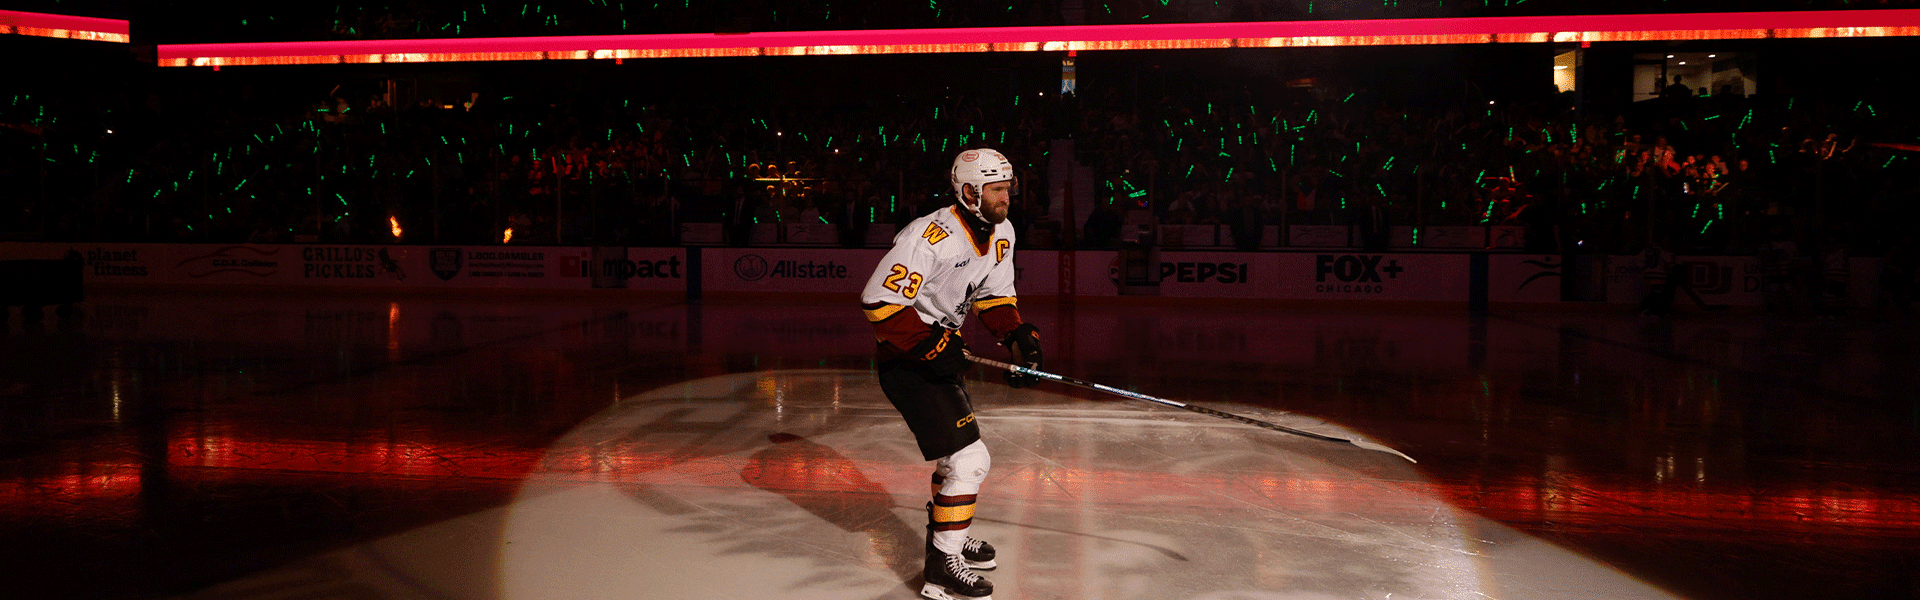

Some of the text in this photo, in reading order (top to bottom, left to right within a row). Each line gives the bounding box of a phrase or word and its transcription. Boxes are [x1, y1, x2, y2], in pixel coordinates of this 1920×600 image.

[922, 221, 949, 246] W
[87, 248, 137, 265] planet
[303, 247, 375, 262] GRILLO'S
[93, 263, 148, 276] fitness
[304, 263, 375, 278] PICKLES
[770, 260, 847, 279] Allstate
[1159, 262, 1247, 284] PEPSI
[882, 263, 923, 300] 23
[1316, 285, 1384, 293] CHICAGO
